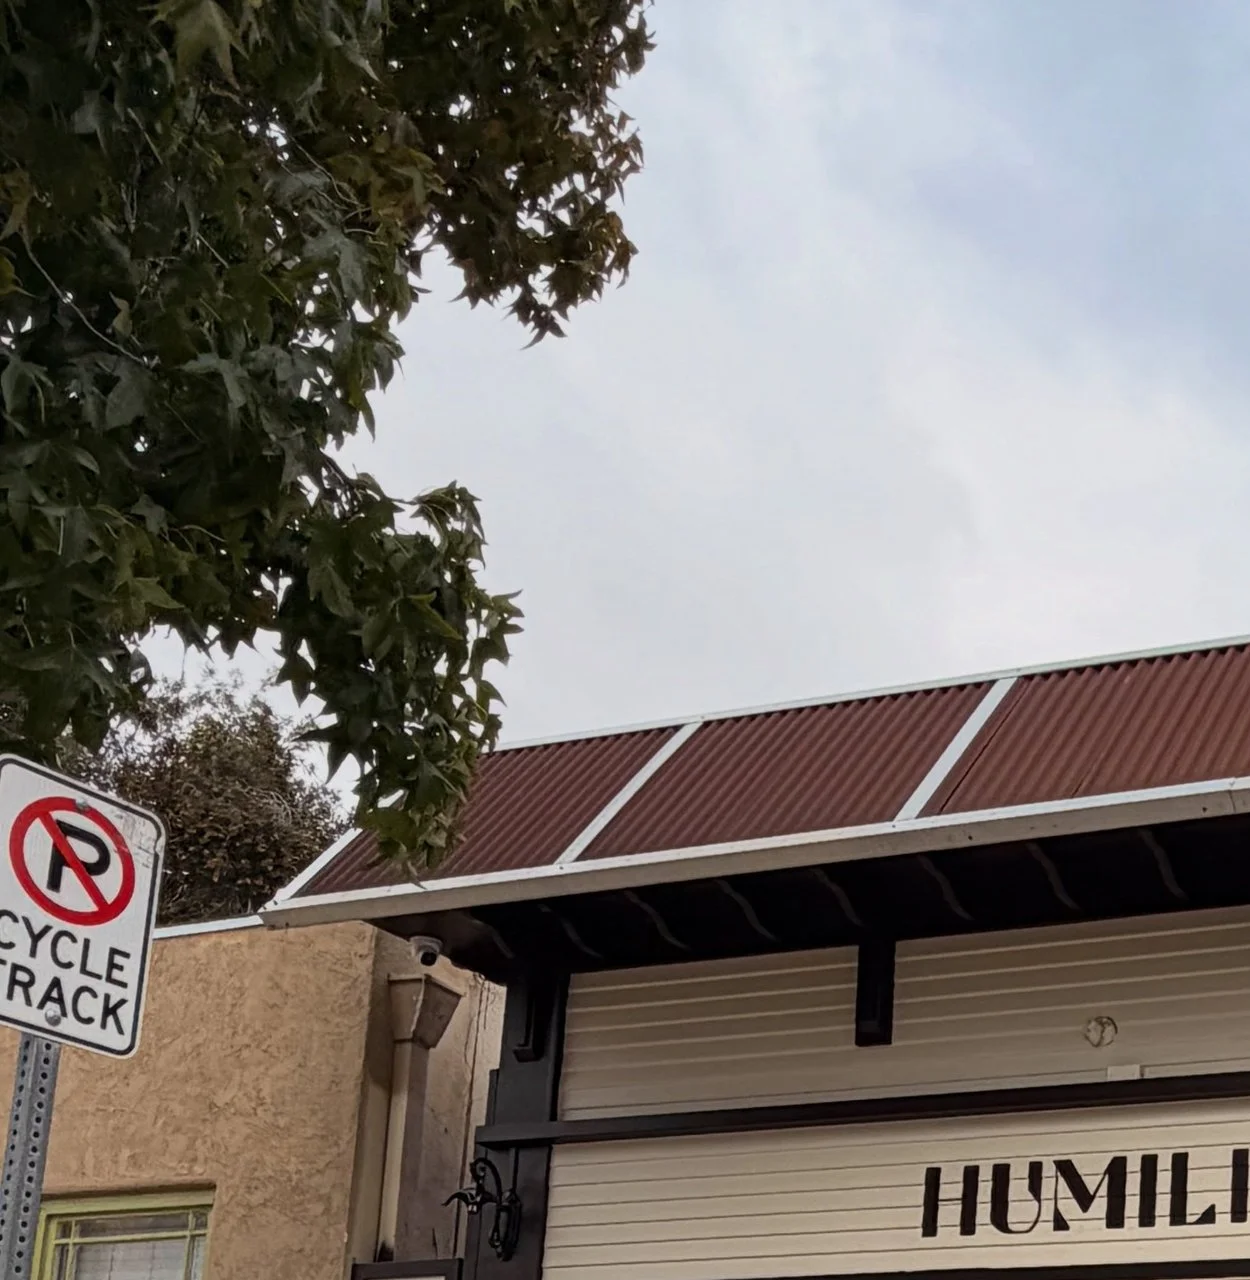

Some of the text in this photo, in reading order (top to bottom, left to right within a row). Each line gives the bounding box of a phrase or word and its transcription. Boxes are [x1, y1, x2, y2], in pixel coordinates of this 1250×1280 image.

[0, 909, 131, 989] CYCLE
[0, 958, 129, 1036] RACK
[921, 1148, 1250, 1238] HUMILI
